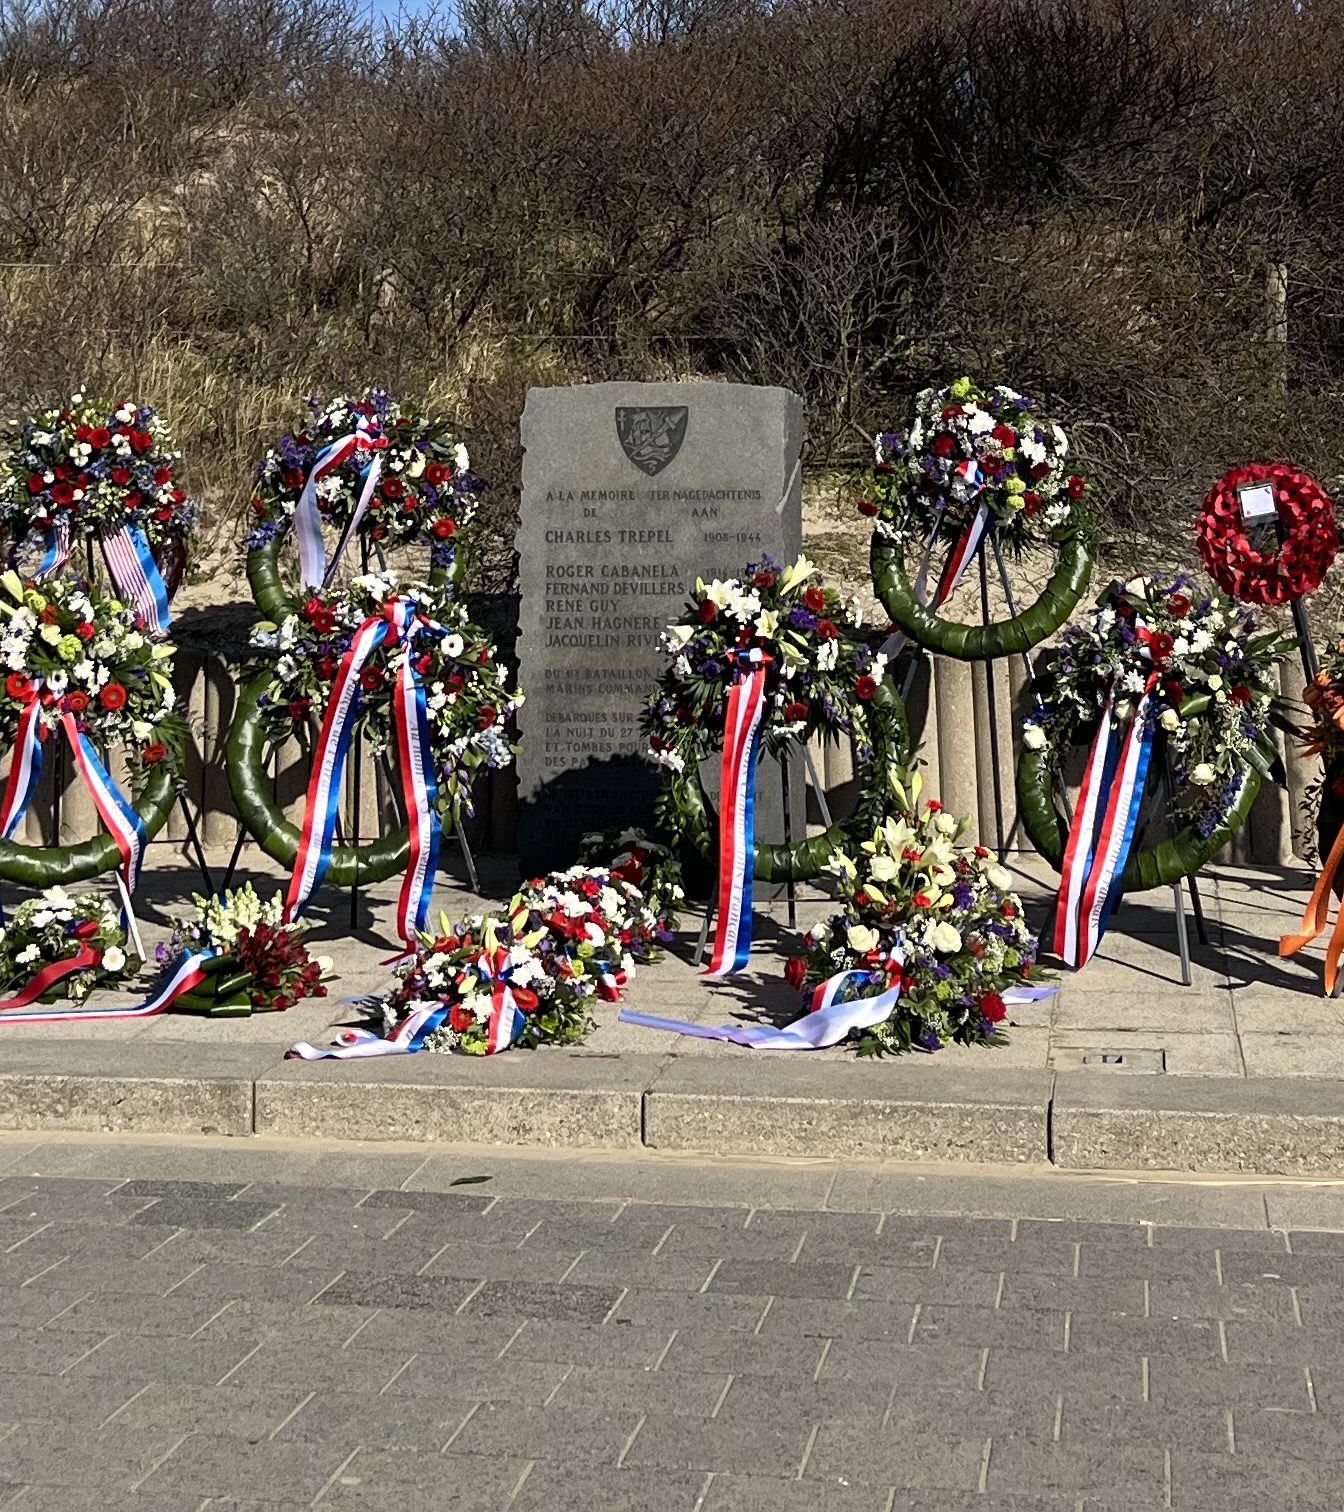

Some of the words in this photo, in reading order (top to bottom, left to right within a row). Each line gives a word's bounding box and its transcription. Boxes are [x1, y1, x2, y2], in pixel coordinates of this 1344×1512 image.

[546, 491, 554, 501] A
[559, 491, 575, 501] LA
[580, 490, 636, 501] MEMOIRE
[648, 490, 670, 501] TER
[672, 489, 762, 501] NAGEDACHTENIS
[584, 508, 598, 518] DE
[692, 508, 719, 518] AAN
[545, 530, 612, 544] CHARLES
[618, 530, 674, 543] TREPEL
[546, 565, 594, 578] ROGER
[601, 564, 680, 578] CABANELA
[546, 583, 610, 596] FERNAND
[613, 582, 685, 595] DEVILLERS
[546, 600, 583, 613] RENE
[590, 599, 621, 612] GUY
[546, 617, 589, 630] JEAN
[592, 616, 660, 630] HAGNERE
[545, 634, 620, 648] JACQUELIN
[584, 669, 654, 680] BATAILLON
[545, 684, 593, 694] MARINS
[545, 713, 609, 723] DEBARQUES
[612, 713, 634, 723] SUR
[545, 728, 561, 738] LA
[567, 728, 593, 738] NUIT
[600, 728, 615, 738] DU
[620, 728, 633, 738] 27
[545, 743, 559, 753] ET
[567, 743, 613, 753] TOMBES
[619, 743, 649, 752] POUR
[545, 757, 566, 767] DES
